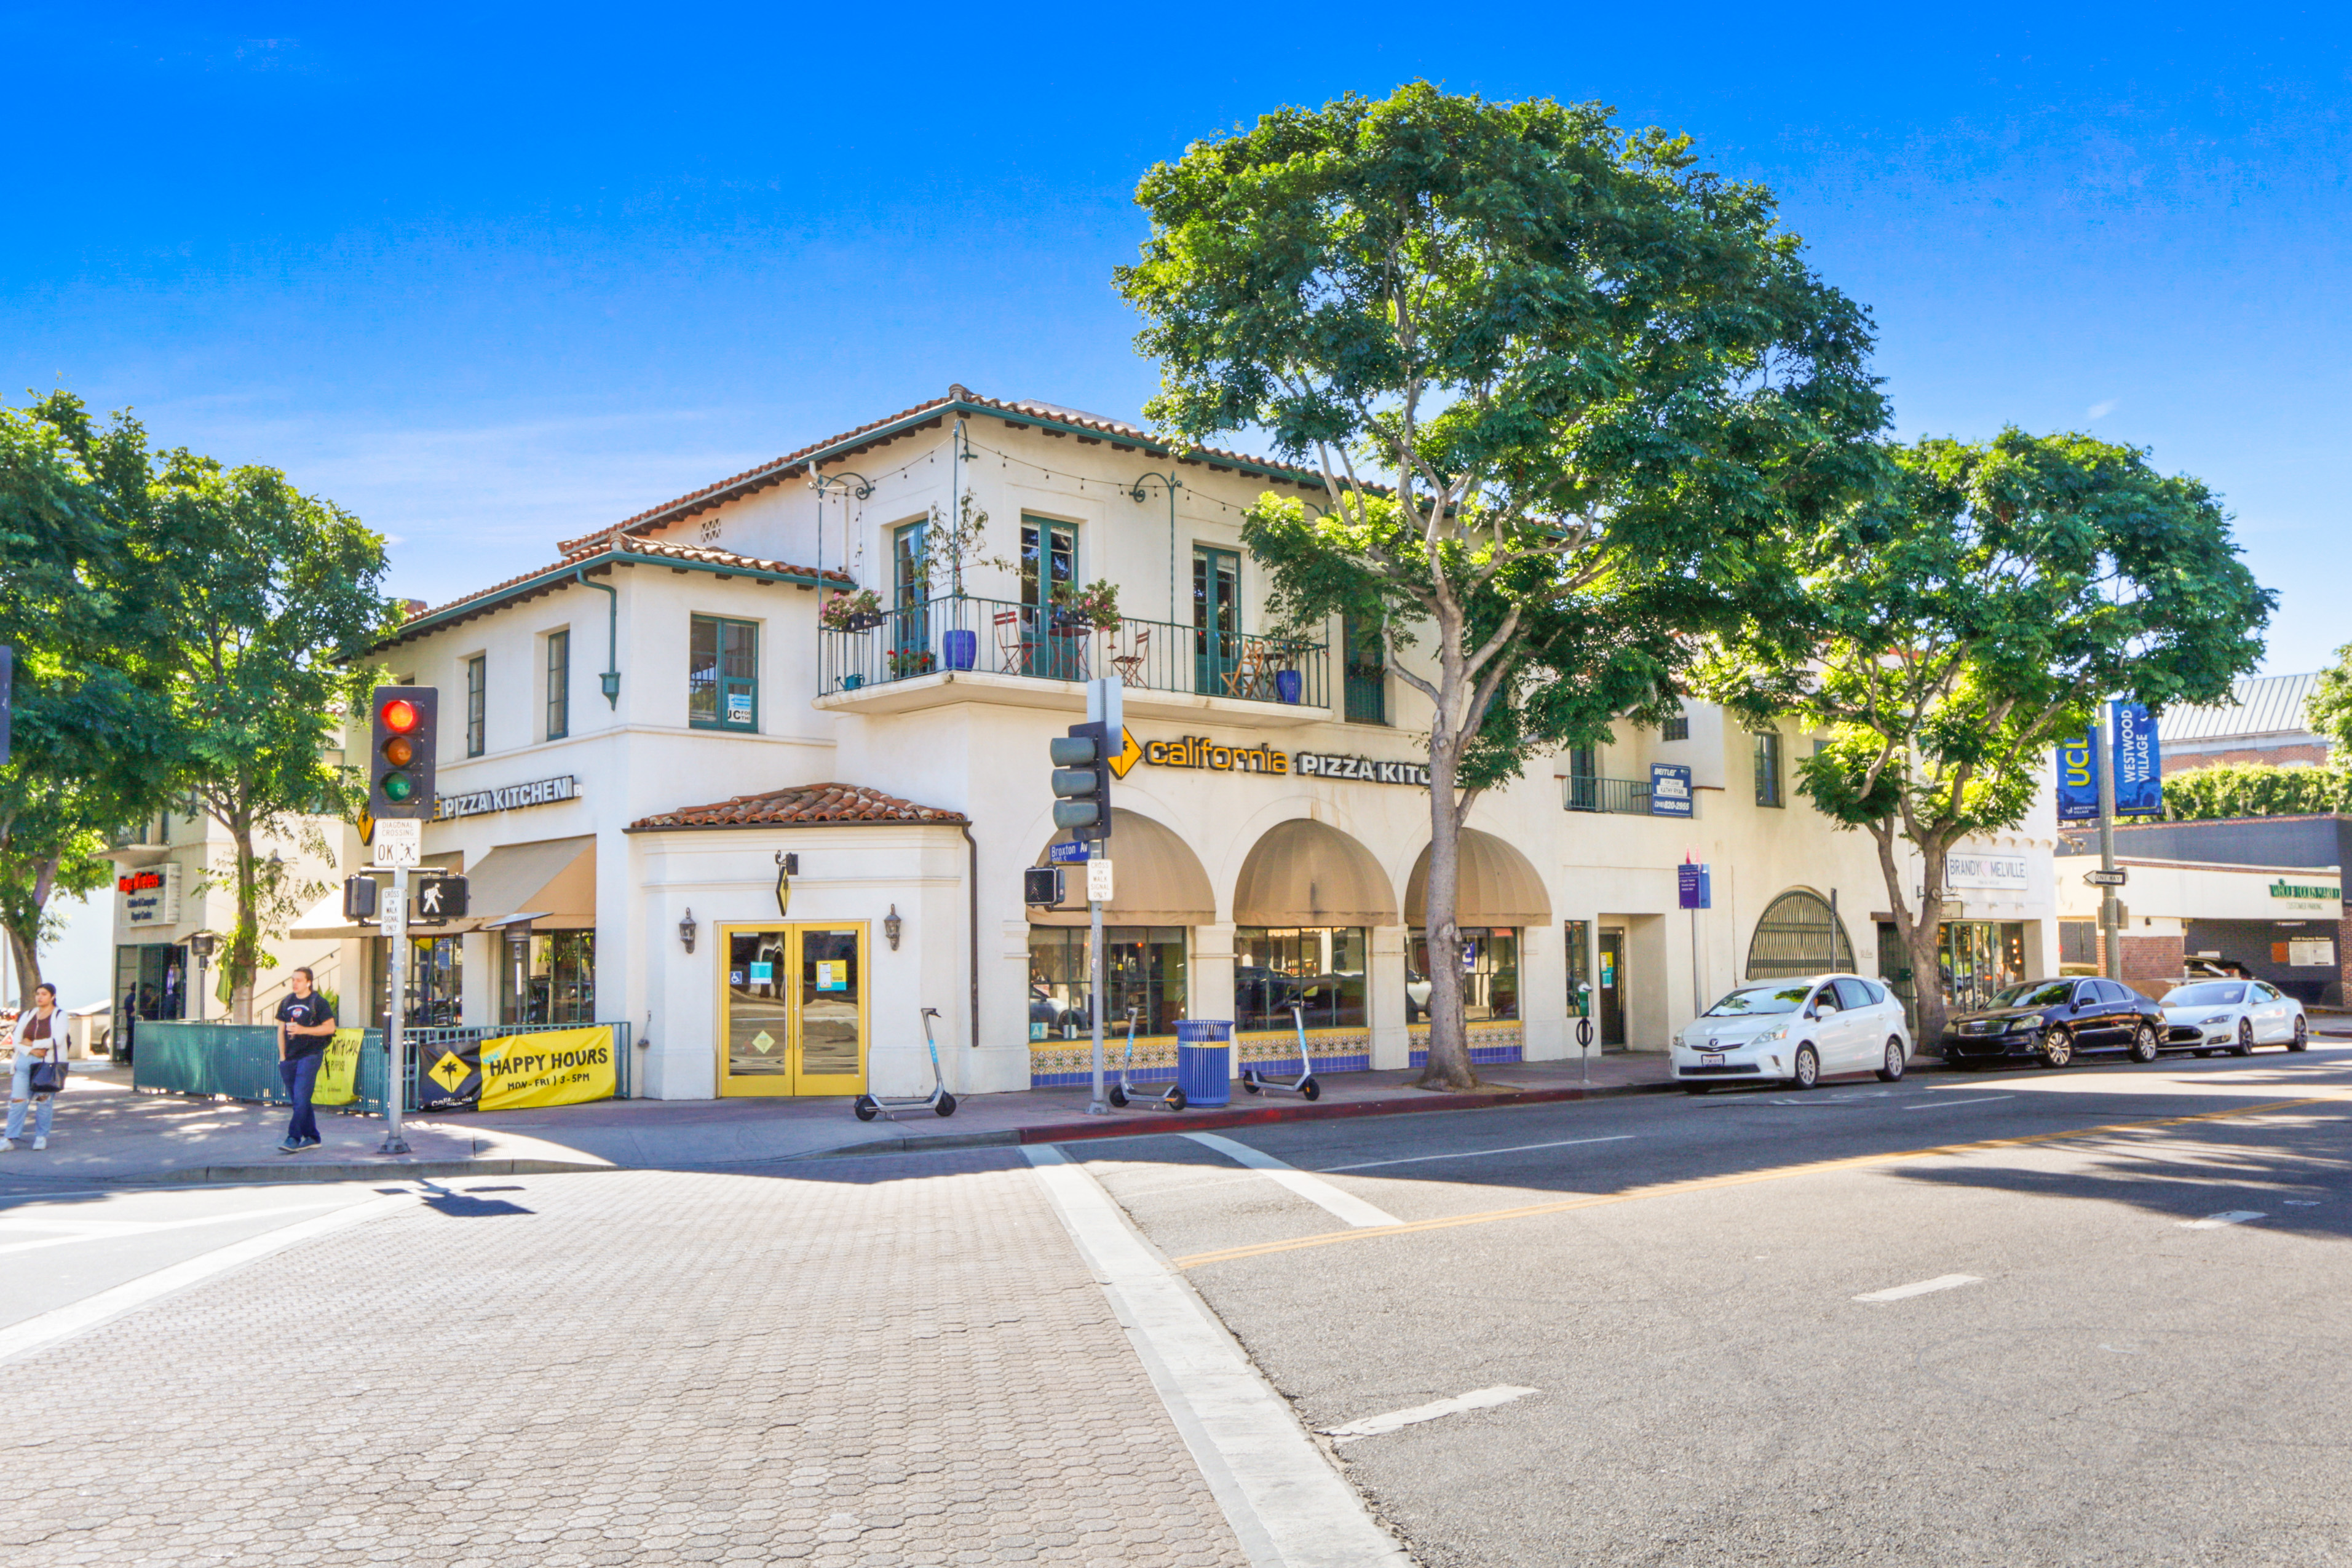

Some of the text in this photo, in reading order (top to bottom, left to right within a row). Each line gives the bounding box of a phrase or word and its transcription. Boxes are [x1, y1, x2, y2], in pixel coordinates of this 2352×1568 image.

[1149, 737, 1289, 772] california
[1300, 754, 1374, 780] PIZZA
[2121, 710, 2136, 783] WESTWOOD
[2136, 734, 2150, 782] VILLAGE
[2065, 737, 2090, 786] UCL
[445, 792, 489, 817] PIZZA
[493, 777, 568, 810] KITCHEN
[378, 844, 394, 860] OK
[1051, 842, 1088, 857] Broxton Av
[1950, 859, 2025, 877] BRANDY MELVILLE
[2270, 885, 2295, 898] WHOLE
[2296, 886, 2316, 898] FOODS
[1032, 1026, 1040, 1036] A
[482, 1051, 502, 1065] NEW!
[490, 1047, 608, 1077] HAPPY HOURS
